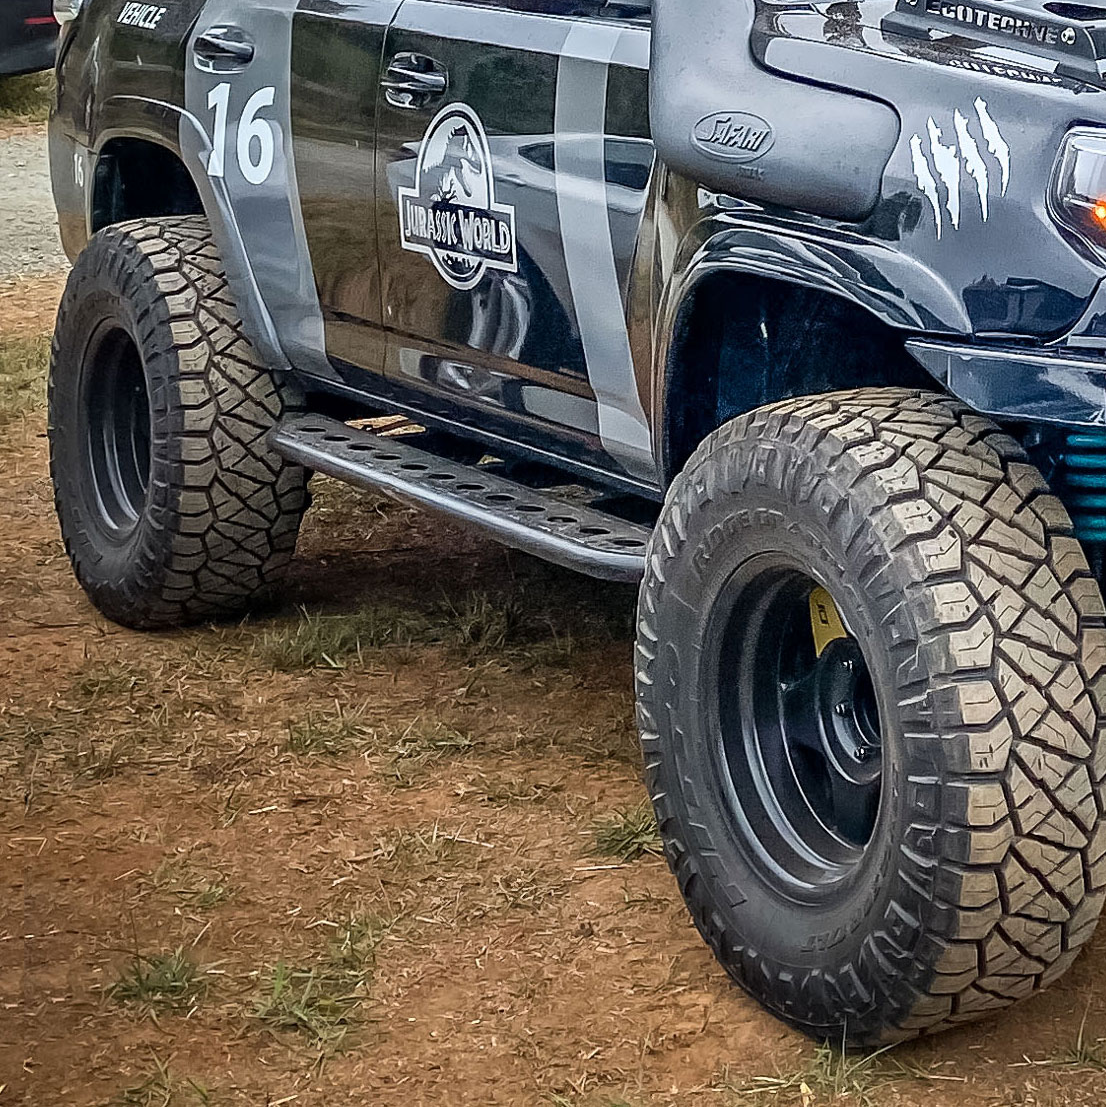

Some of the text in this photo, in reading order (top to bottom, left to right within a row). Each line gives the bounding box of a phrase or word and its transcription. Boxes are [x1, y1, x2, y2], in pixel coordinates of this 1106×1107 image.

[117, 1, 167, 29] VEHICLE
[207, 82, 276, 185] 16
[73, 153, 85, 188] 16
[404, 199, 511, 254] JURASSIC WORLD
